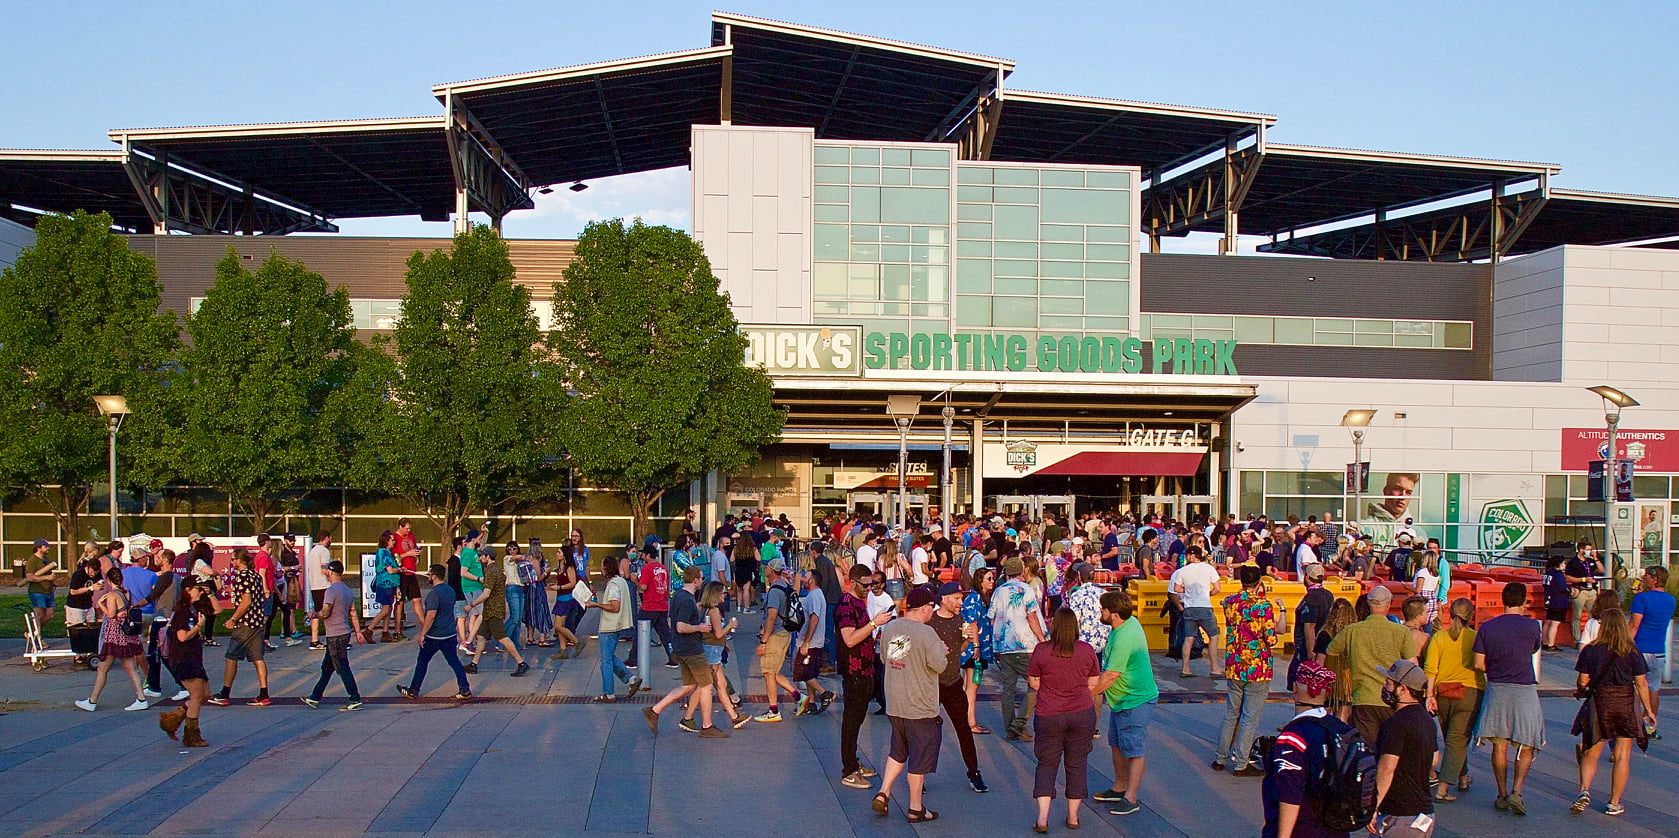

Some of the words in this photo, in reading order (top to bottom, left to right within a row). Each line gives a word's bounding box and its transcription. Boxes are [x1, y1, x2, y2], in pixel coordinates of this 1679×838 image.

[744, 331, 852, 369] DICK'S
[865, 332, 1027, 371] SPORTING
[1037, 335, 1142, 374] GOODS
[1152, 337, 1238, 376] PARK
[1131, 429, 1177, 447] GATE
[1181, 429, 1194, 447] G
[1616, 432, 1665, 441] AUTHENTICS
